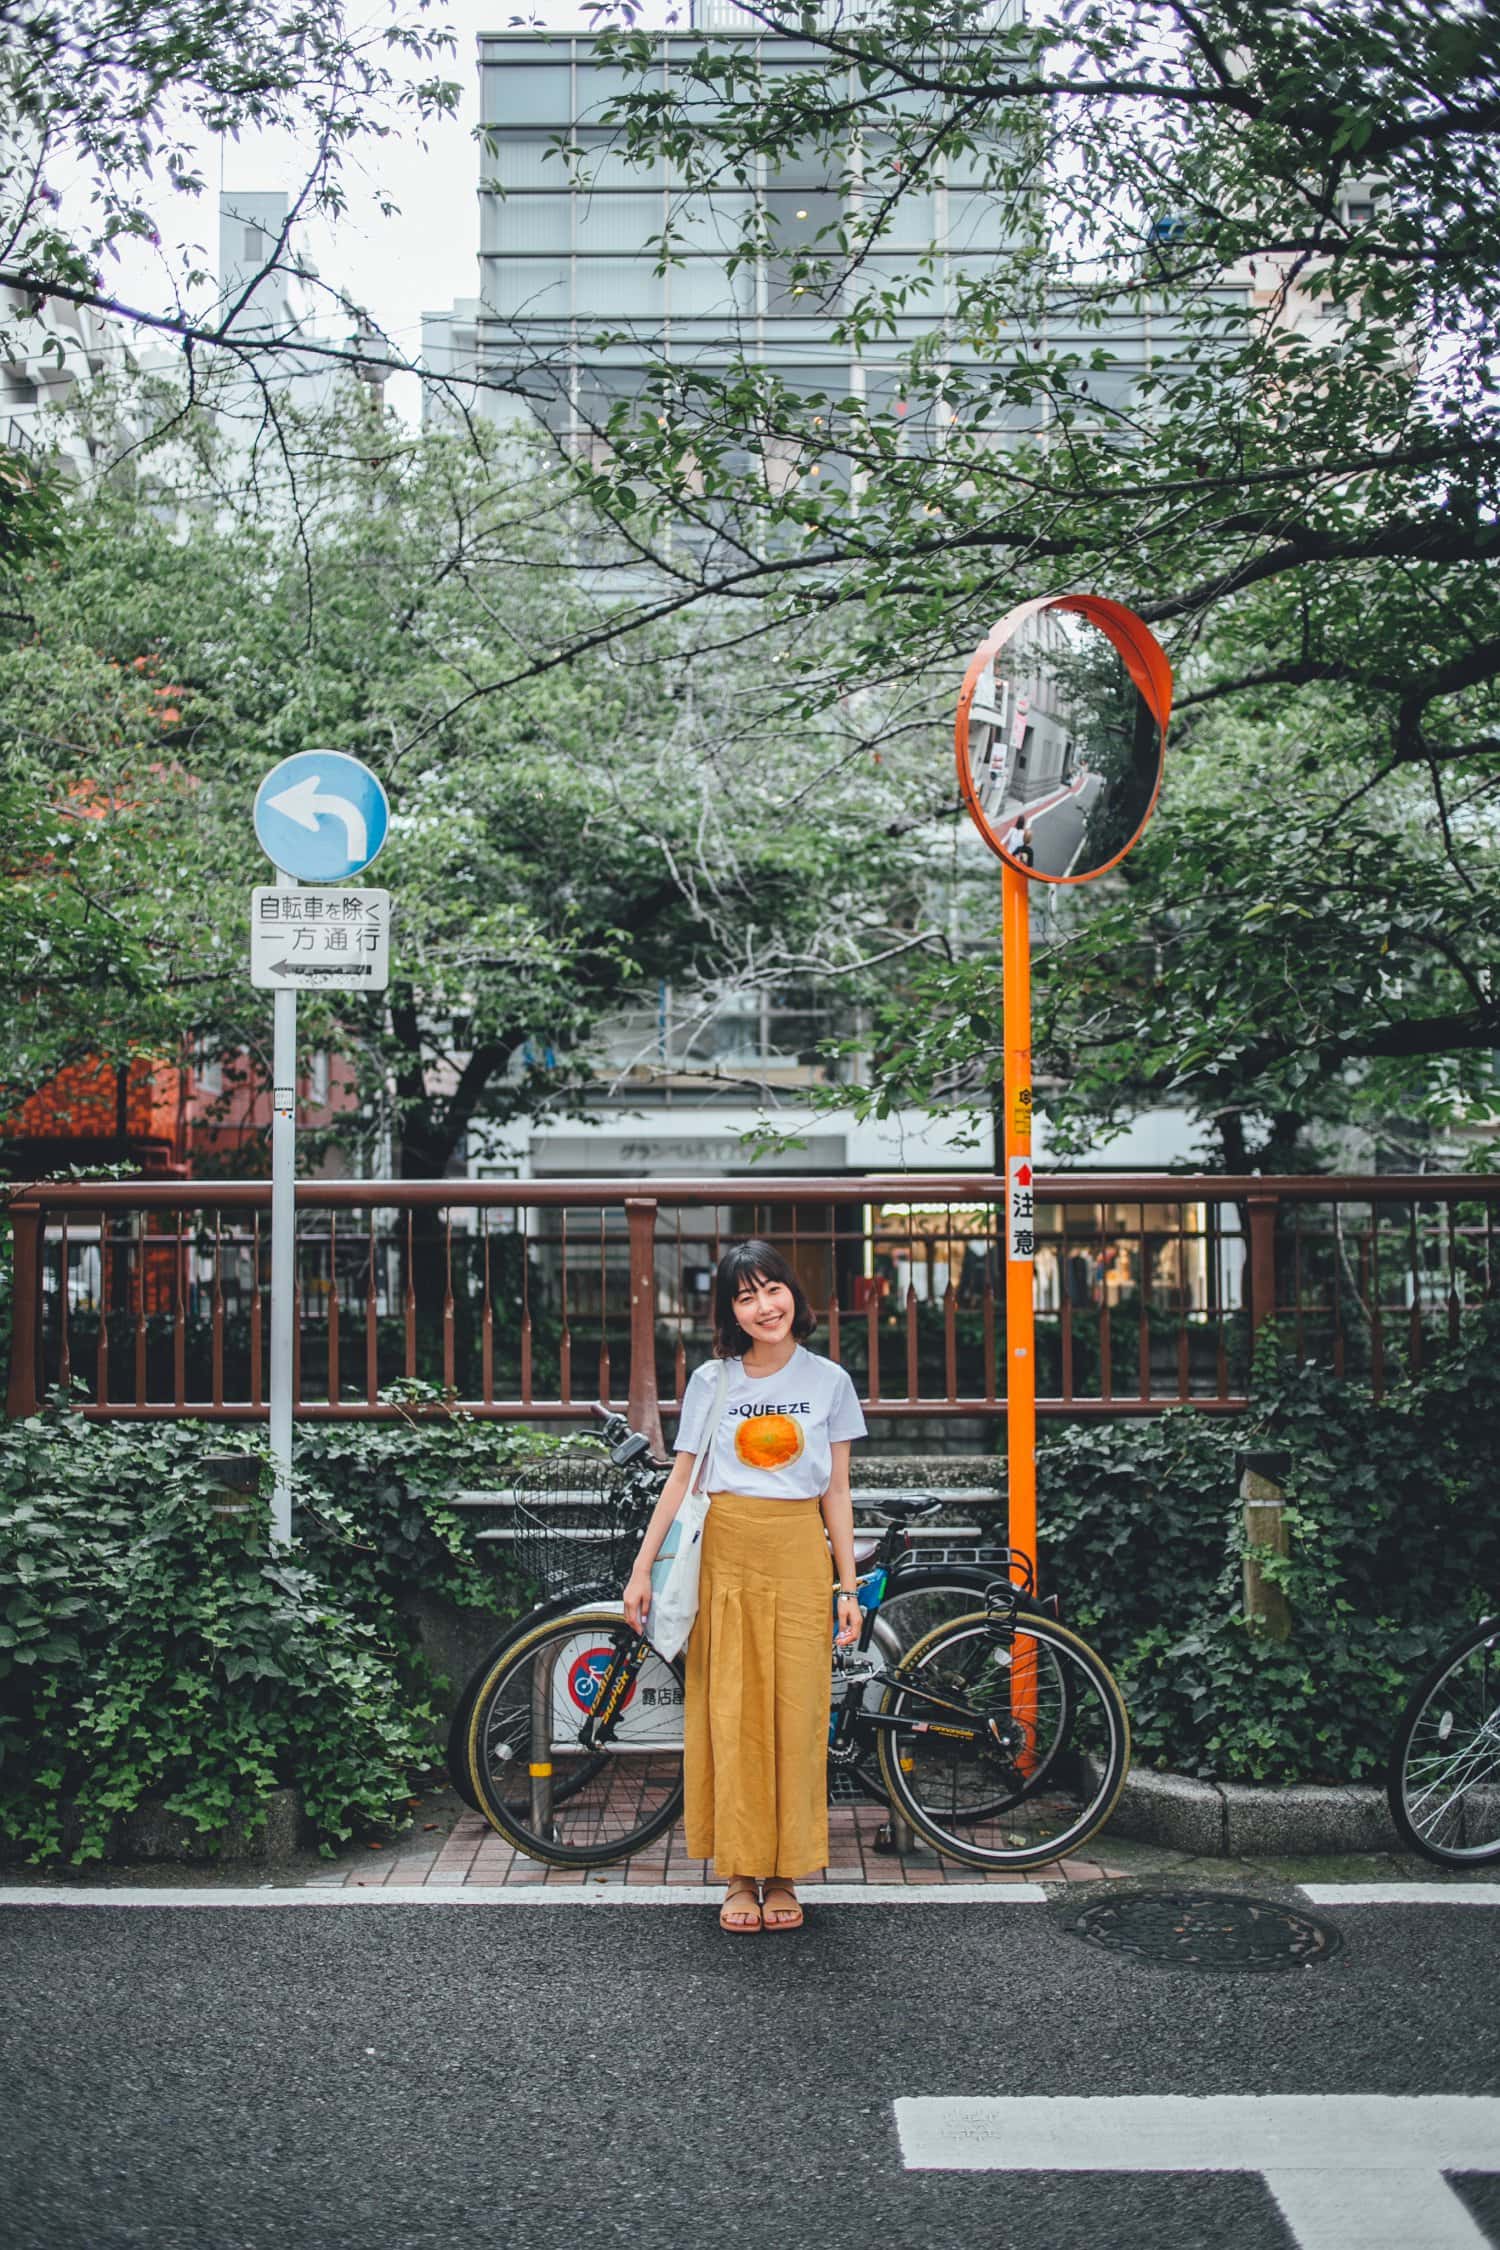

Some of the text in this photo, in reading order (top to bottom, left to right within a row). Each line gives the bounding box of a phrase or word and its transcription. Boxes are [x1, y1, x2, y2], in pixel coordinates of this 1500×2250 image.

[261, 896, 380, 920] 自転車を除く
[260, 927, 380, 952] 一方通行
[1013, 1192, 1033, 1255] 注意
